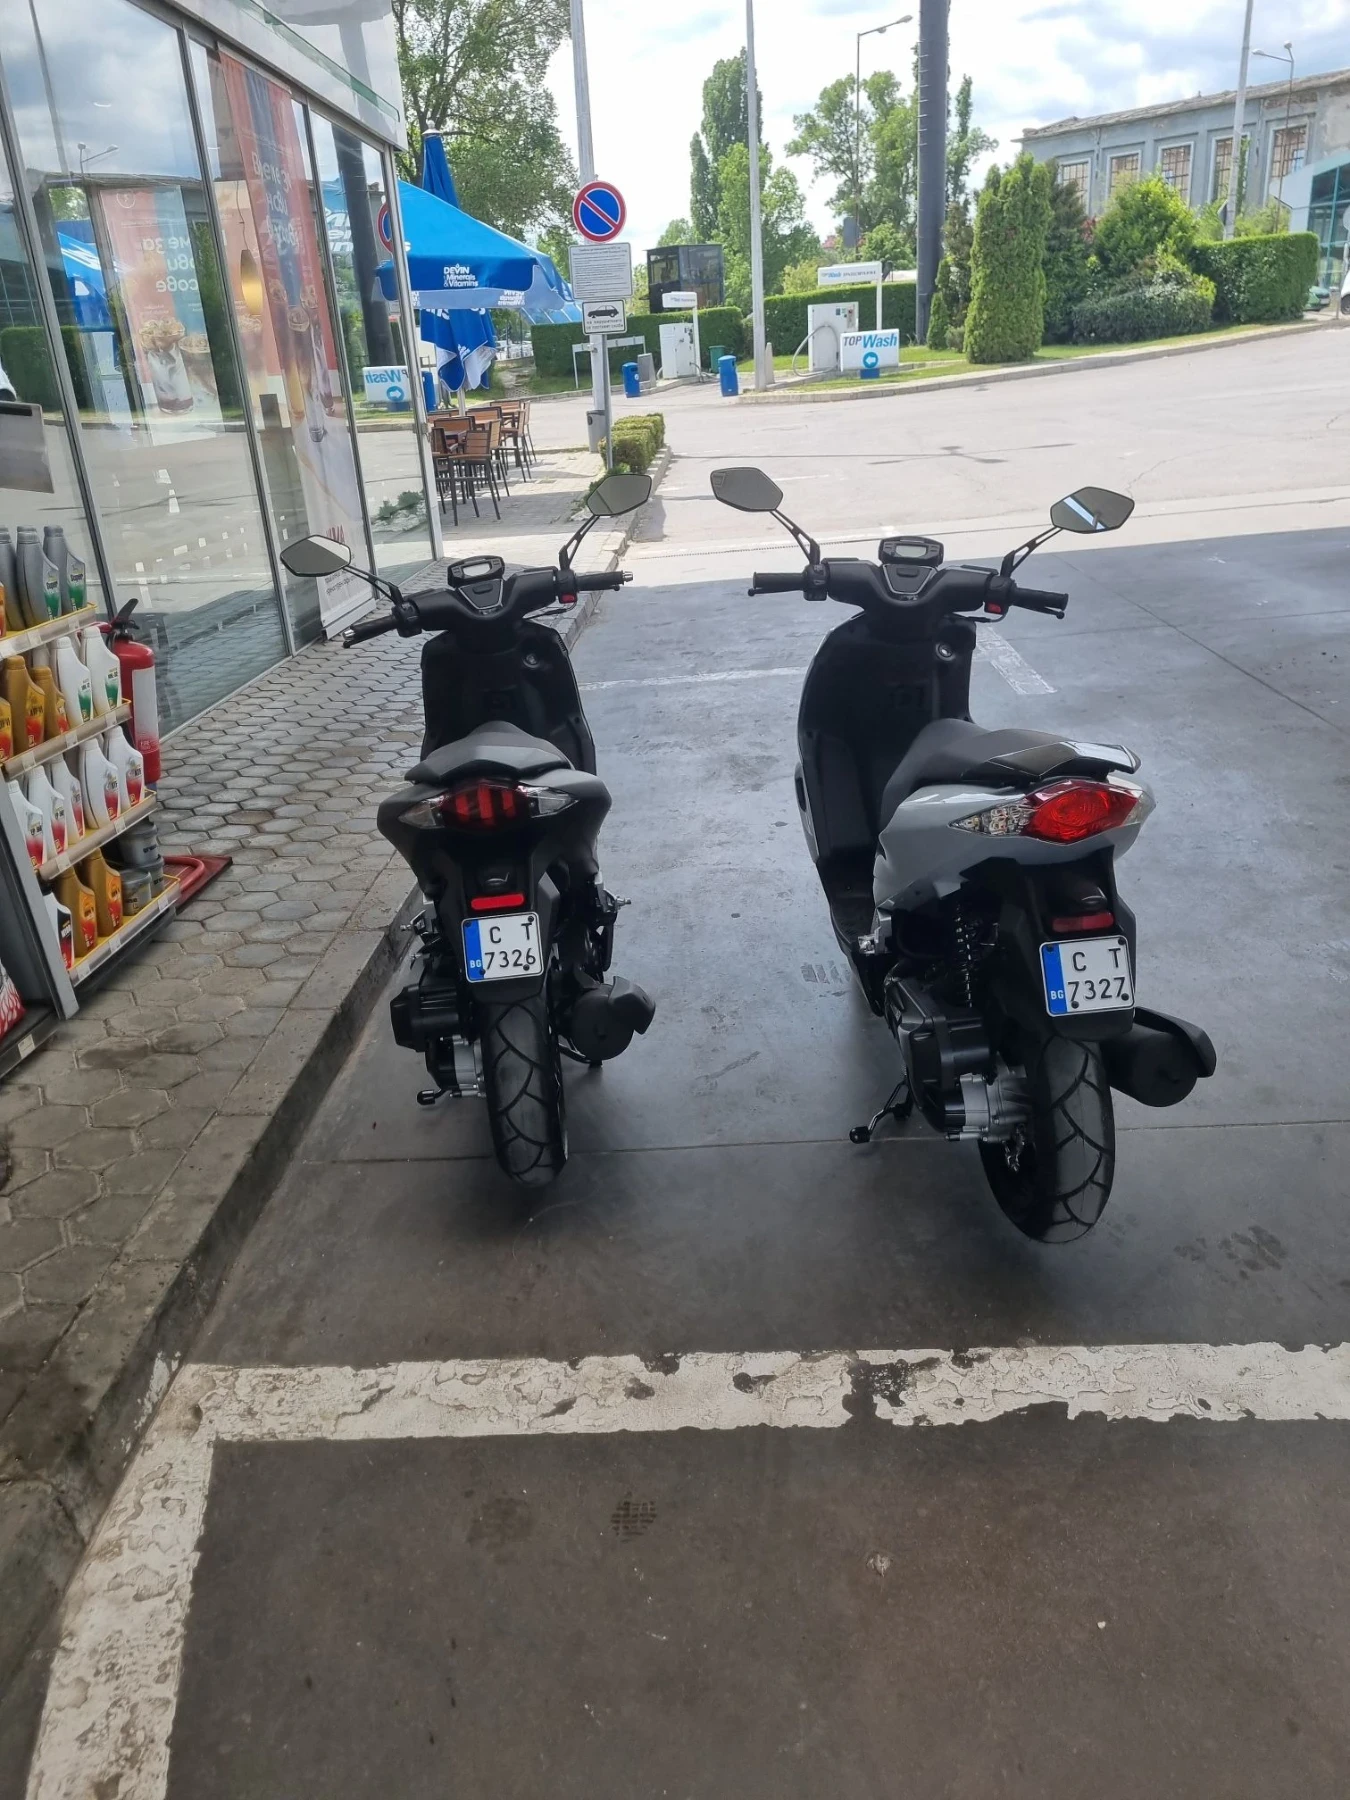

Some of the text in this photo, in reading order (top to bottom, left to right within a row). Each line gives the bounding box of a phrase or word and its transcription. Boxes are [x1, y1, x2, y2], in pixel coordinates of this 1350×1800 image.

[443, 265, 470, 275] DEVIN
[446, 273, 476, 281] Minerals
[469, 947, 537, 970] BG 7326
[1050, 976, 1126, 1002] BG 7327
